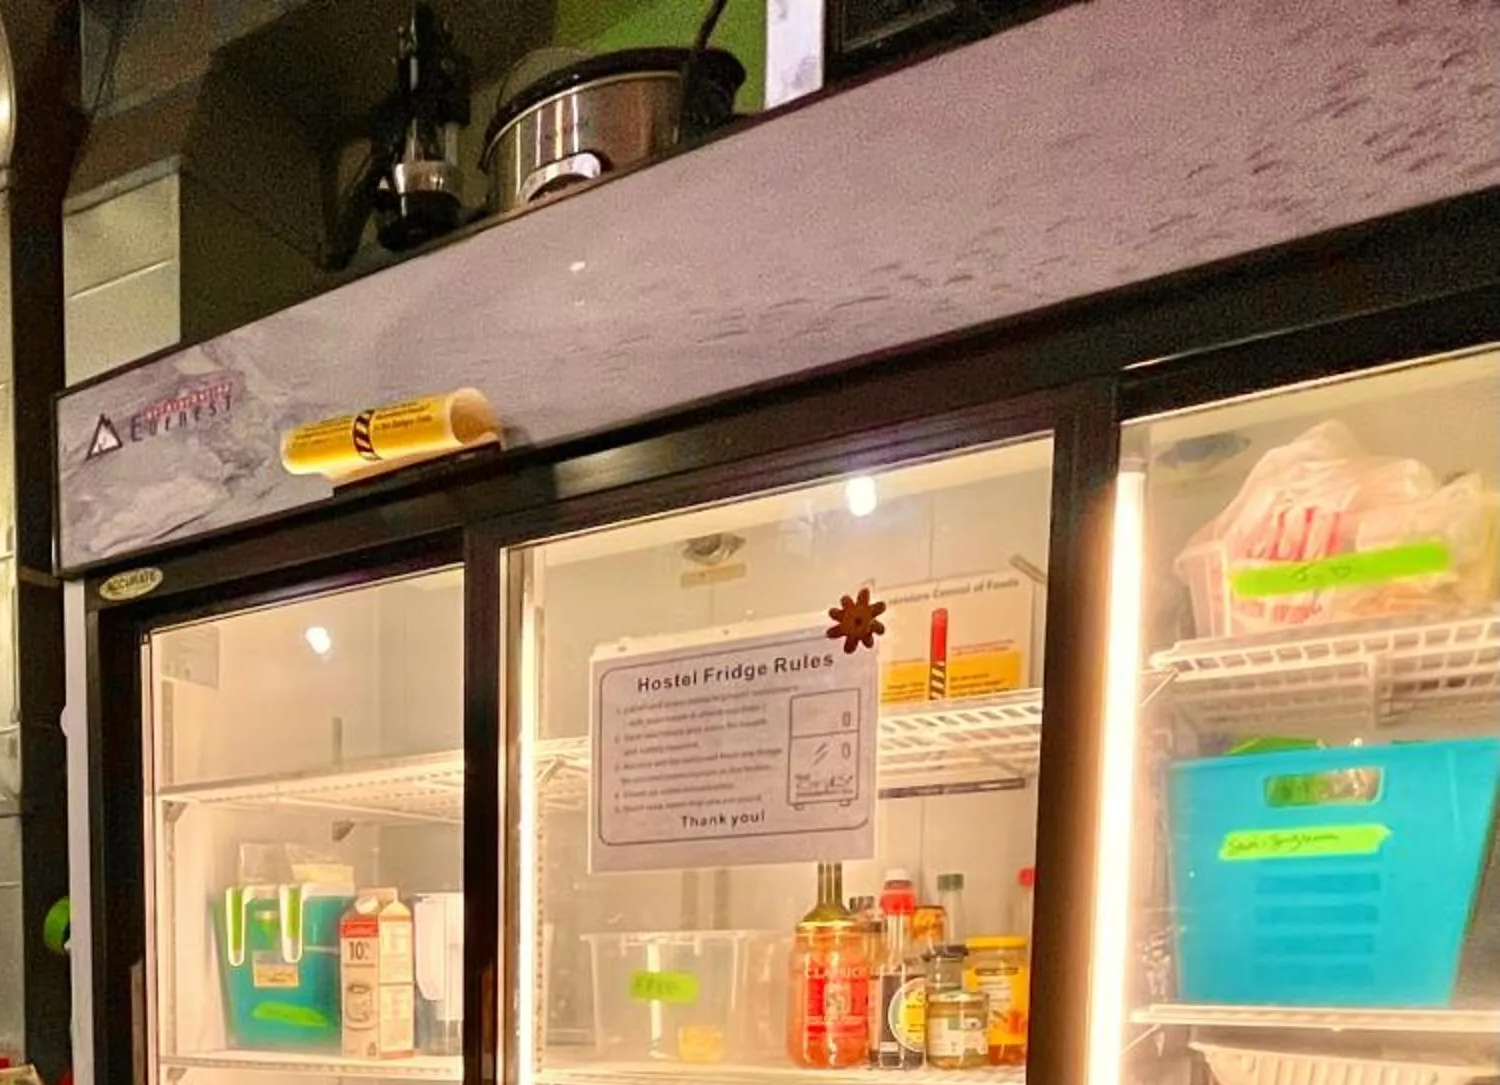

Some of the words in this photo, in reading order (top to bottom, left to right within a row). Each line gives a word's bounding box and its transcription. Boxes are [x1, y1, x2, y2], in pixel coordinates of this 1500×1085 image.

[637, 669, 698, 693] Hostel
[704, 663, 767, 683] Fridge
[774, 653, 835, 674] Rules
[681, 811, 726, 828] Thank
[731, 807, 766, 830] you!
